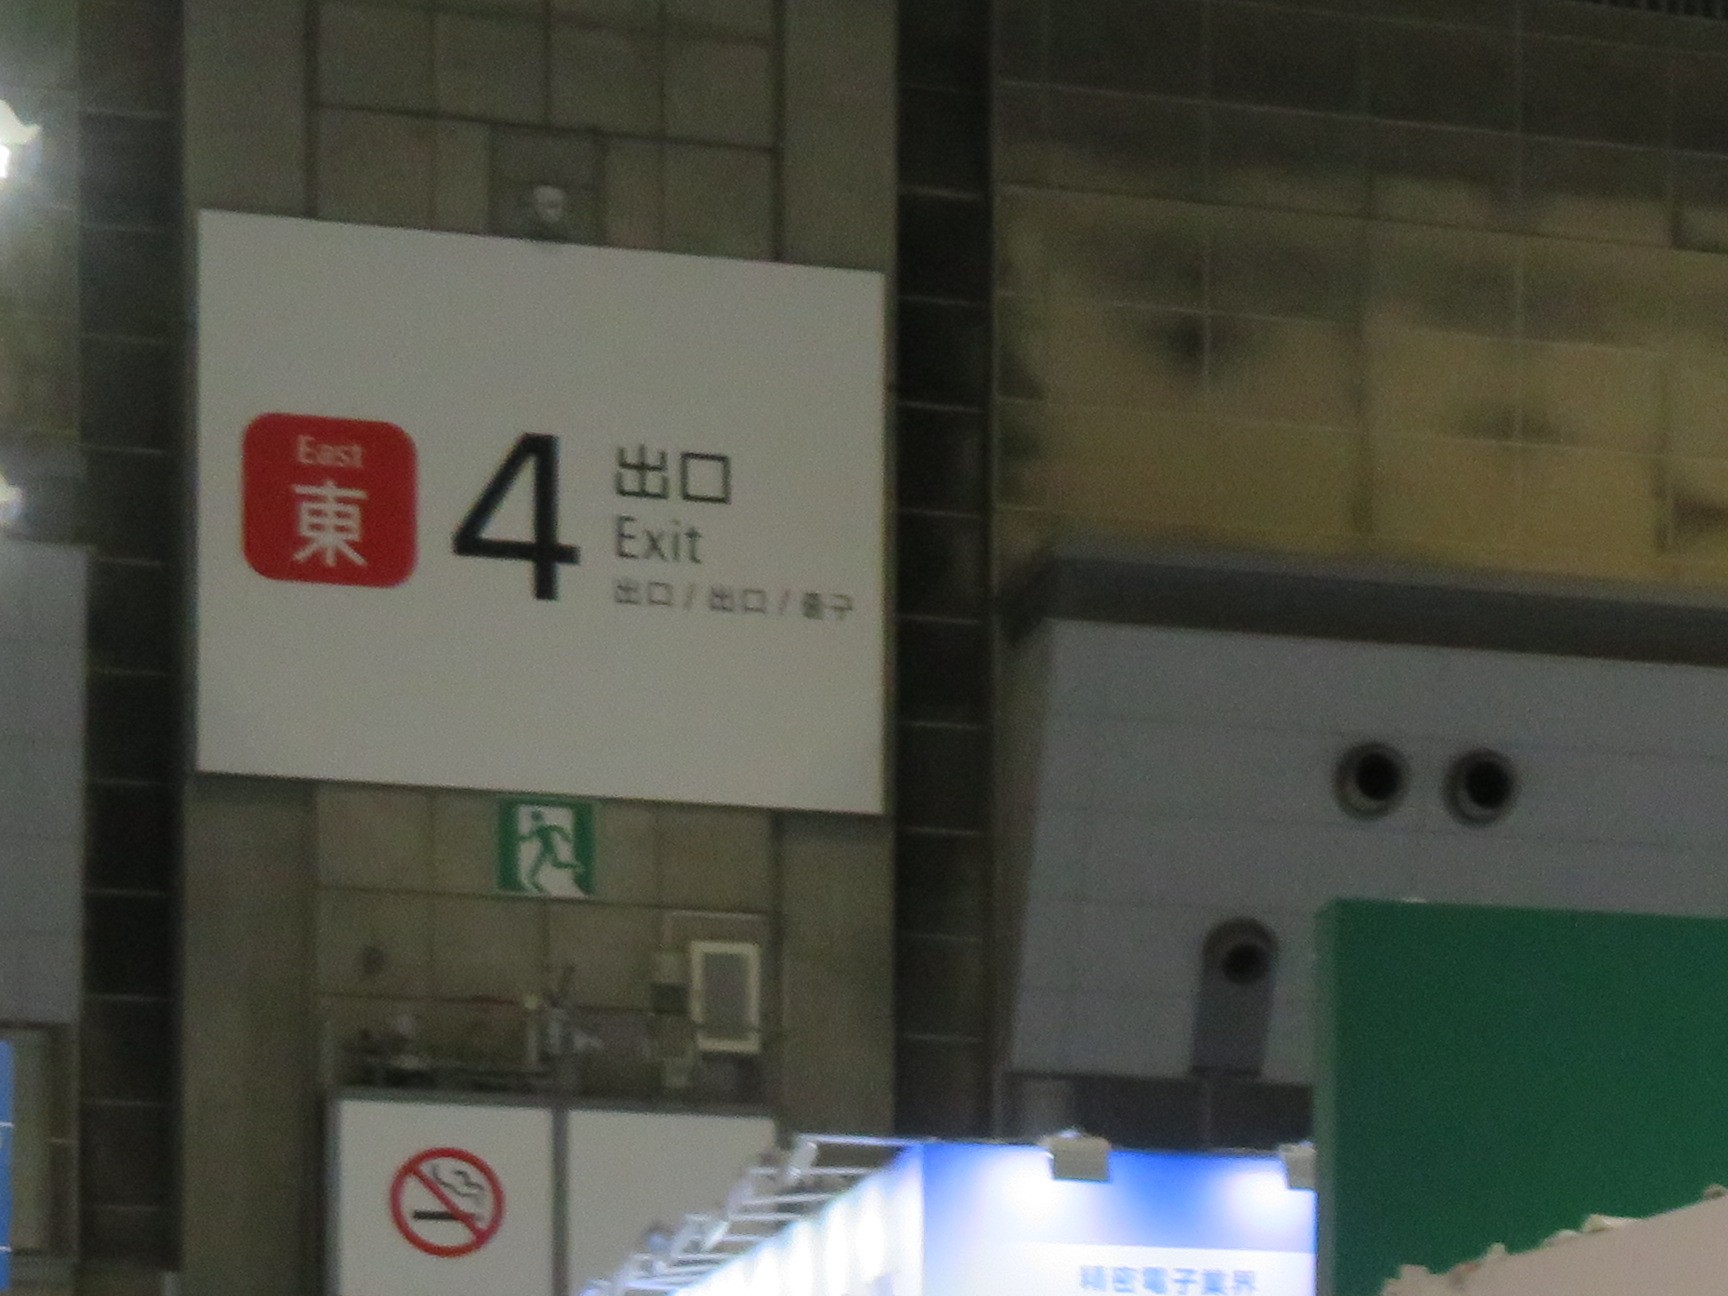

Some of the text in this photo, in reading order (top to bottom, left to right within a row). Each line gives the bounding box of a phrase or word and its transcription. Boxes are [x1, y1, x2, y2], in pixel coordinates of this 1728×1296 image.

[297, 436, 364, 469] East
[614, 442, 733, 504] 出口
[291, 481, 368, 568] 東
[452, 432, 581, 601] 4
[614, 515, 704, 565] Exit
